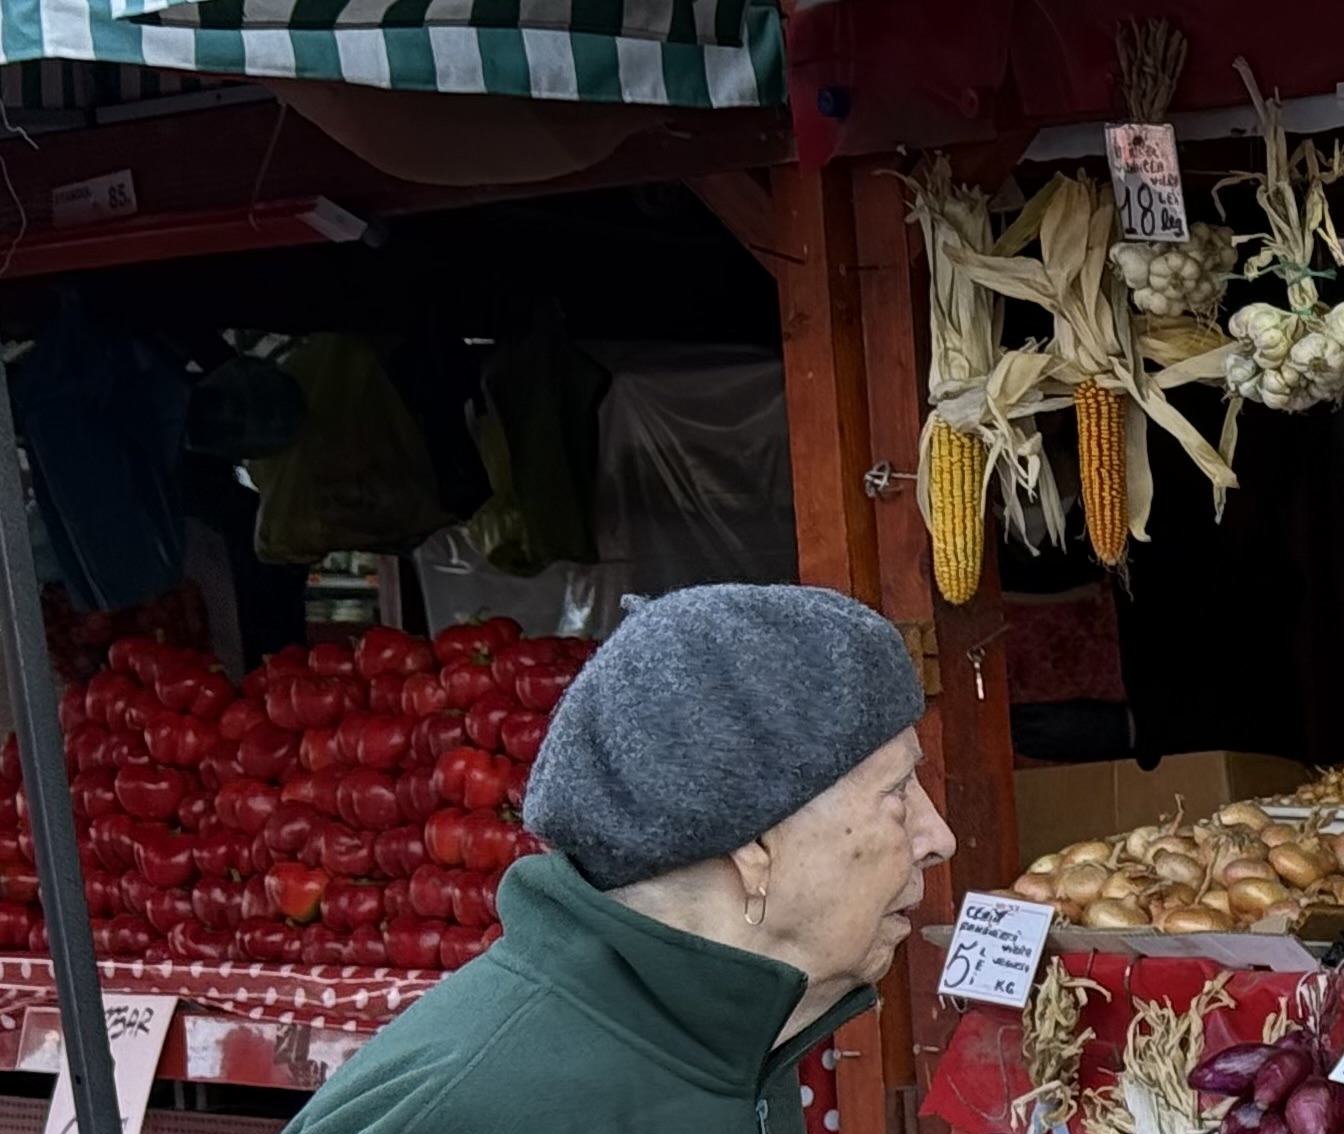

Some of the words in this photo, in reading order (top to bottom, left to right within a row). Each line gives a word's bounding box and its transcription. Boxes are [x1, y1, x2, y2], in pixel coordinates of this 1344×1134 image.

[1119, 182, 1156, 237] 18
[944, 941, 978, 989] 5
[994, 980, 1016, 995] KG
